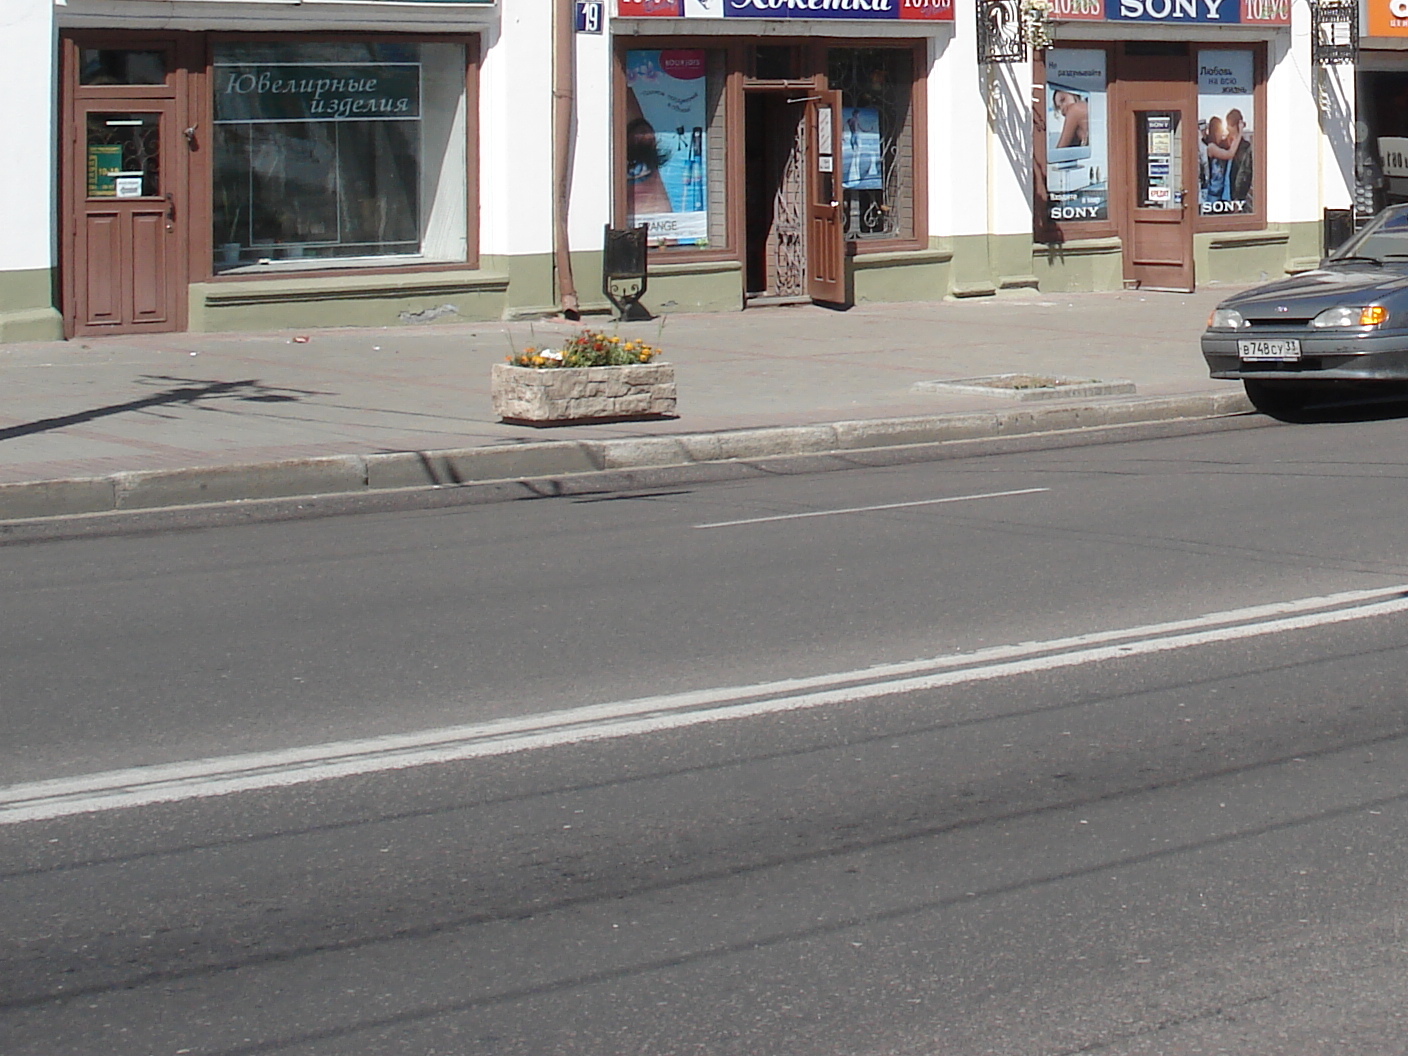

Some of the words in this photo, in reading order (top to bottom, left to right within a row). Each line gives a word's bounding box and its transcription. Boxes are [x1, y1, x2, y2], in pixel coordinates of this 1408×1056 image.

[581, 3, 598, 32] 19
[1200, 66, 1232, 76] Любовь
[226, 72, 377, 102] Ювелирные
[310, 95, 409, 118] изделия
[1051, 206, 1099, 219] SONY
[1202, 200, 1246, 213] SONY
